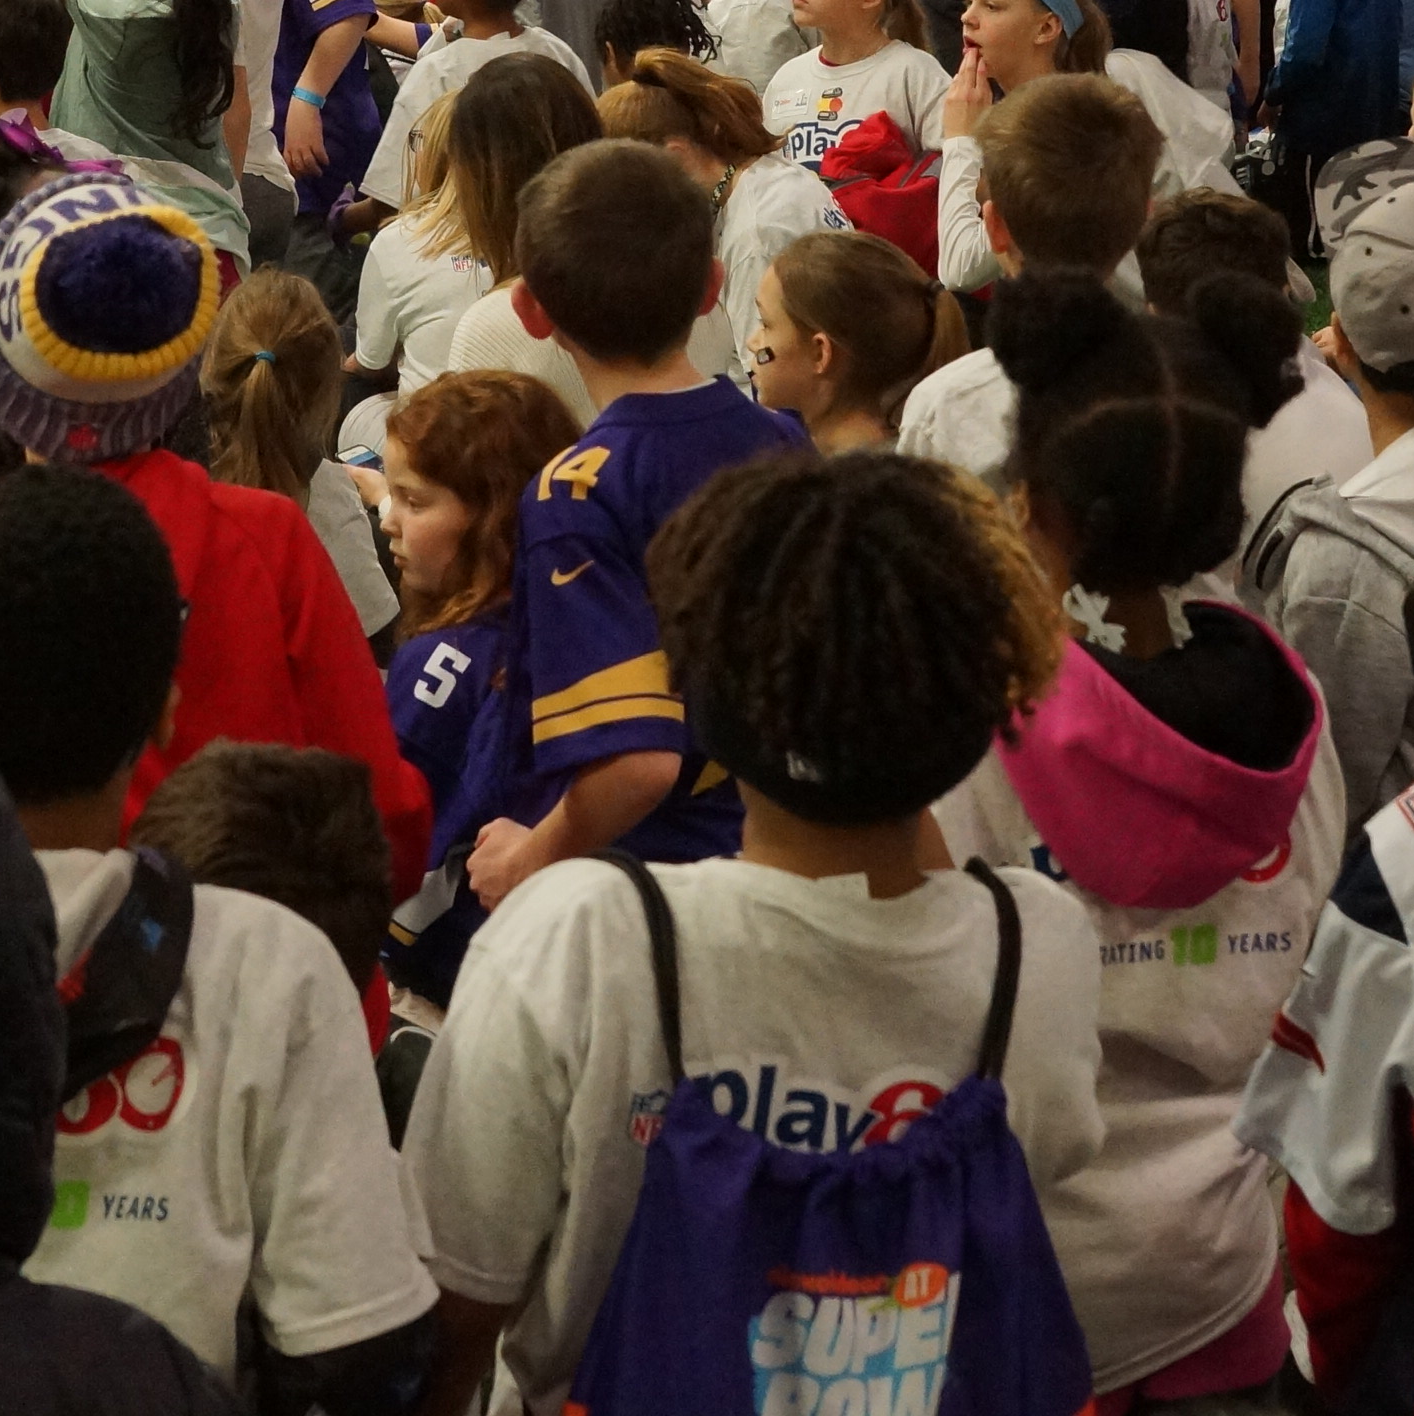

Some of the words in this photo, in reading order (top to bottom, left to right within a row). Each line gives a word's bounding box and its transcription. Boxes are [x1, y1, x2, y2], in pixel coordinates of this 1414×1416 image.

[537, 444, 611, 502] 14
[1228, 932, 1292, 955] YEARS
[103, 1195, 170, 1222] YEARS
